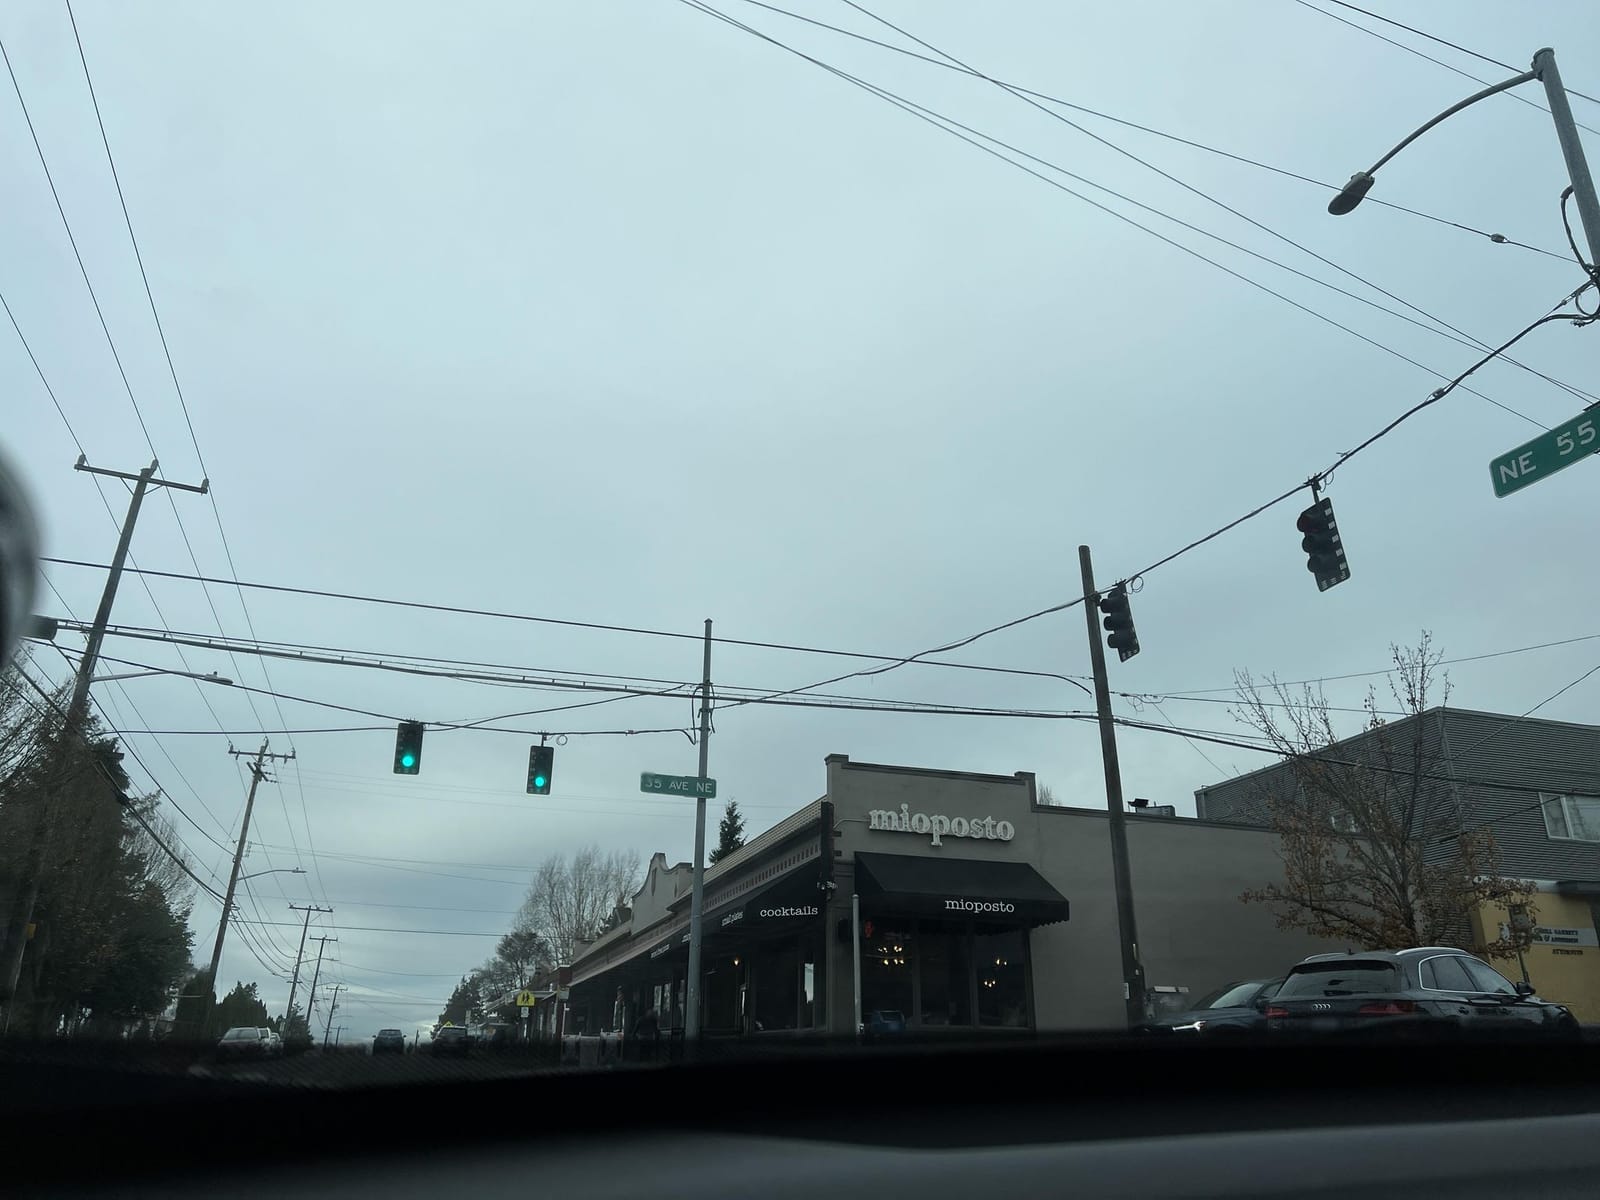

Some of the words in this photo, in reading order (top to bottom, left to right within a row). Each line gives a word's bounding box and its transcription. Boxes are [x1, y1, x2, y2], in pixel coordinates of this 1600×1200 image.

[1499, 451, 1536, 484] NE
[1556, 420, 1596, 456] 55
[668, 781, 688, 791] AVE
[696, 782, 712, 793] NE
[868, 803, 1015, 846] mioposto
[760, 905, 818, 917] cocktails
[944, 899, 1015, 914] mioposto
